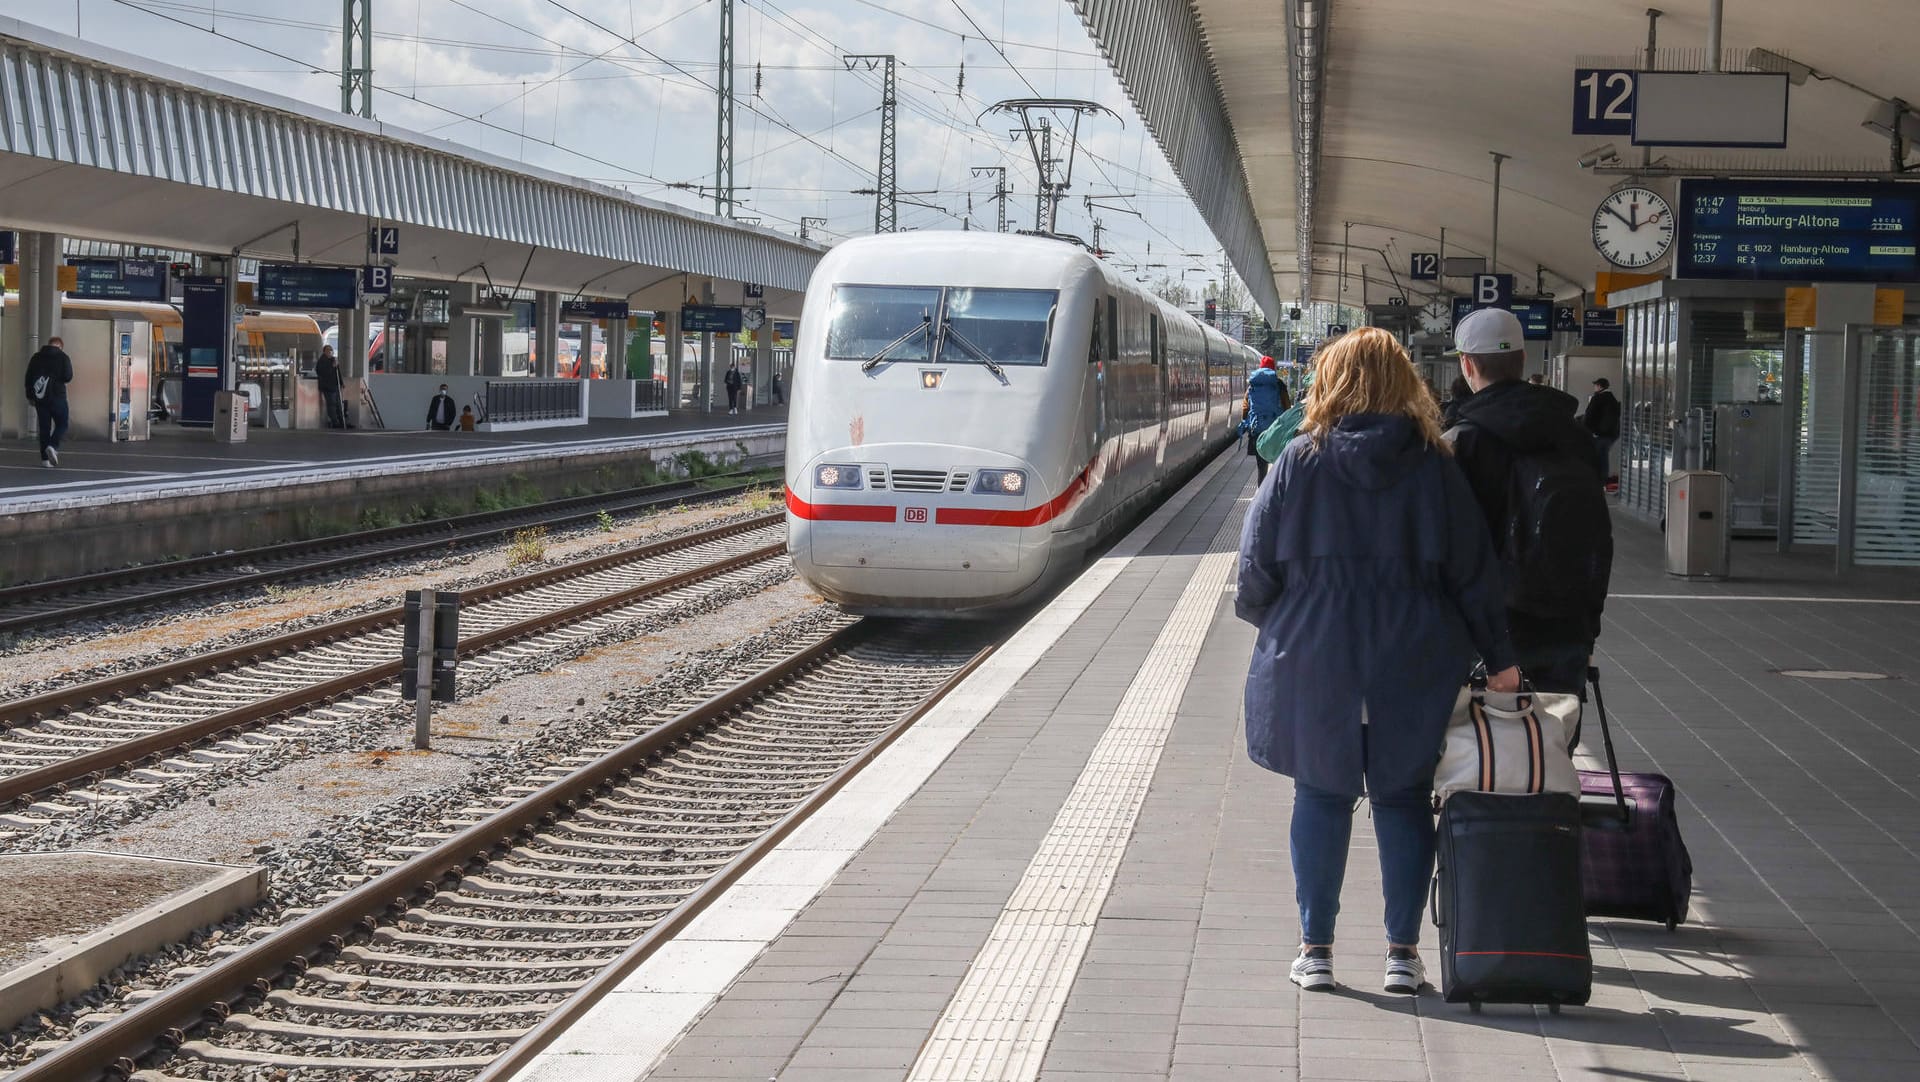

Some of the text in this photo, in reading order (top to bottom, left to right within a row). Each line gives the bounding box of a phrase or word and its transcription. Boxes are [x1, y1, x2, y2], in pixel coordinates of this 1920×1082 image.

[1580, 72, 1633, 119] 12
[1695, 196, 1725, 207] 11:47
[1737, 206, 1765, 214] Hamburg
[1737, 213, 1840, 230] Hamburg-Altona
[1693, 242, 1717, 251] 11:57
[1737, 244, 1750, 252] ICE
[1754, 244, 1772, 252] 1022
[1780, 244, 1850, 255] Hamburg-Altona
[1413, 254, 1436, 274] 12
[1693, 254, 1825, 266] 12:37 RE 2 Osnabrück
[372, 267, 387, 288] B
[748, 284, 761, 295] 14
[1478, 275, 1499, 303] B
[571, 302, 587, 310] 2-12
[907, 509, 925, 521] DB
